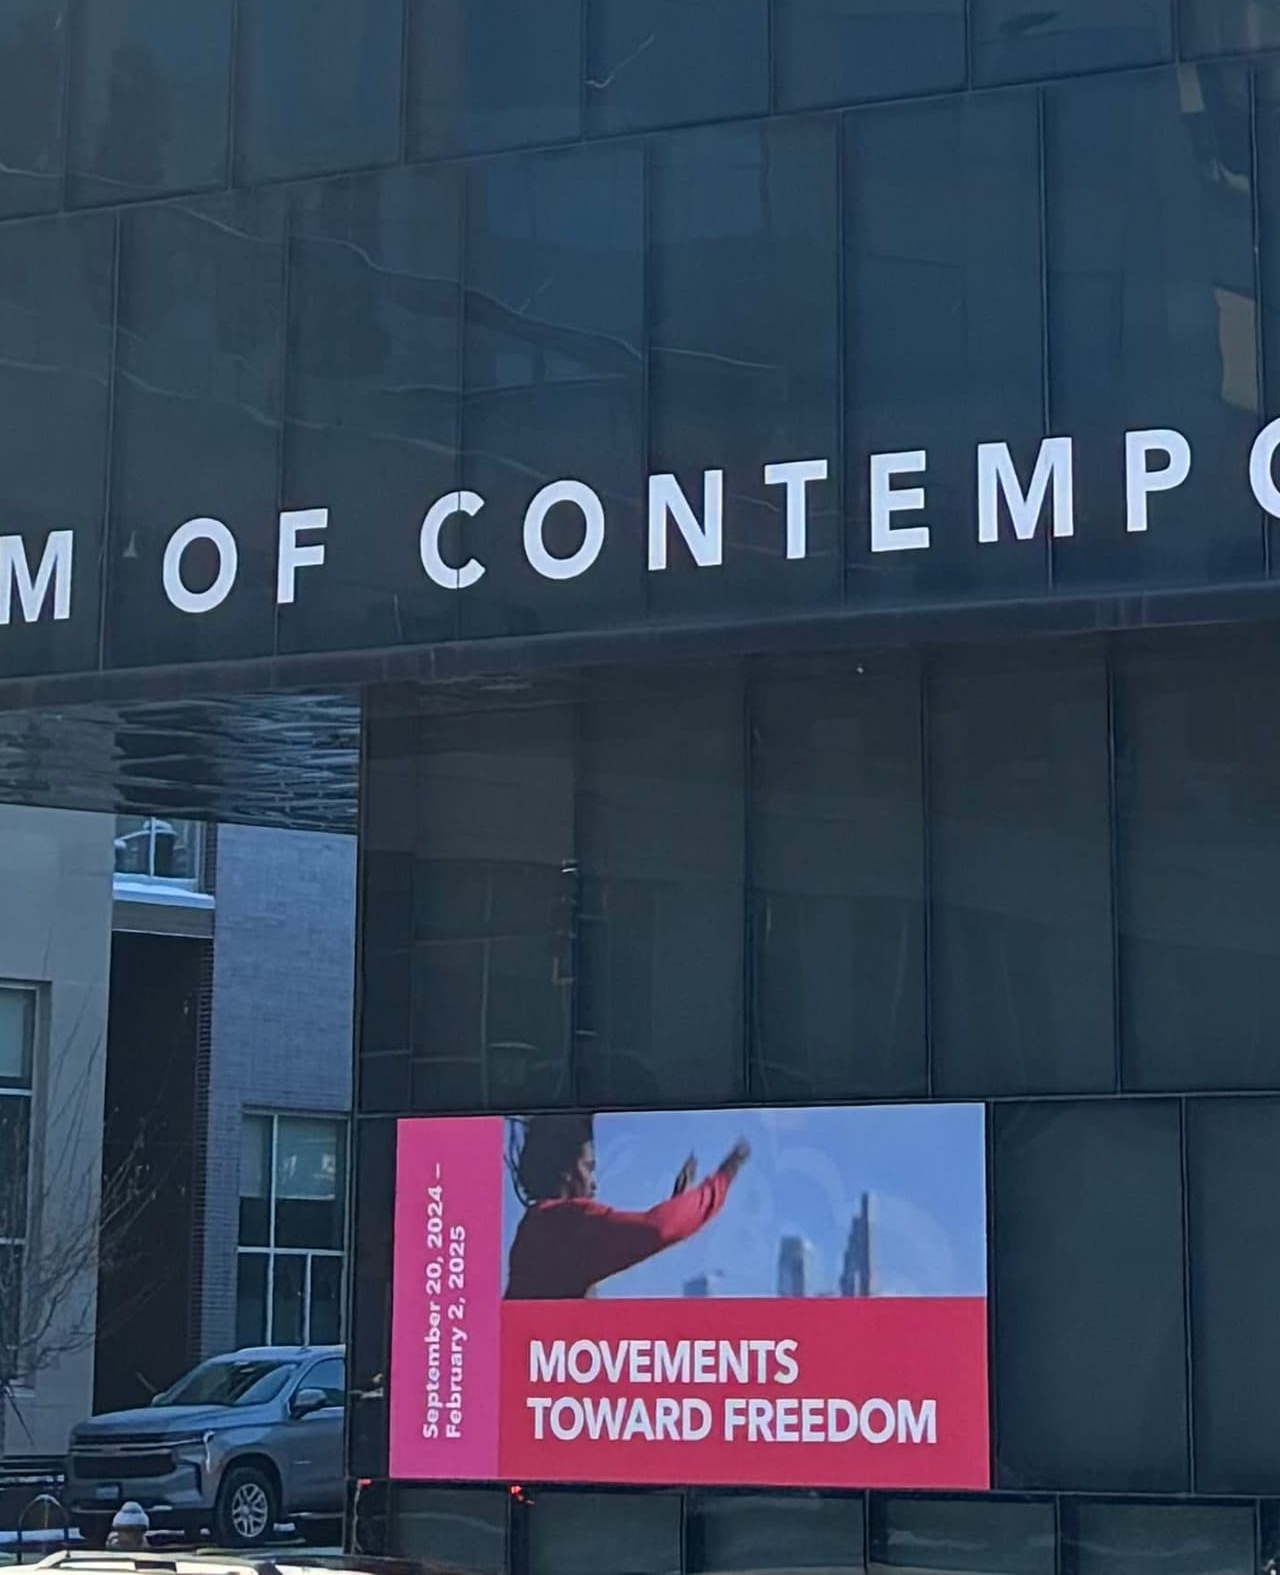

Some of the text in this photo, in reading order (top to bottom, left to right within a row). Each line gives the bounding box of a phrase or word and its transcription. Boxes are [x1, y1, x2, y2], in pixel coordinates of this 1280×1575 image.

[163, 508, 329, 614] OF
[427, 1185, 443, 1248] 2024
[425, 1256, 444, 1295] 20,
[445, 1225, 467, 1438] February 2, 2025
[528, 1338, 799, 1385] MOVEMENTS
[423, 1301, 444, 1438] September
[526, 1396, 938, 1444] TOWARD FREEDOM
